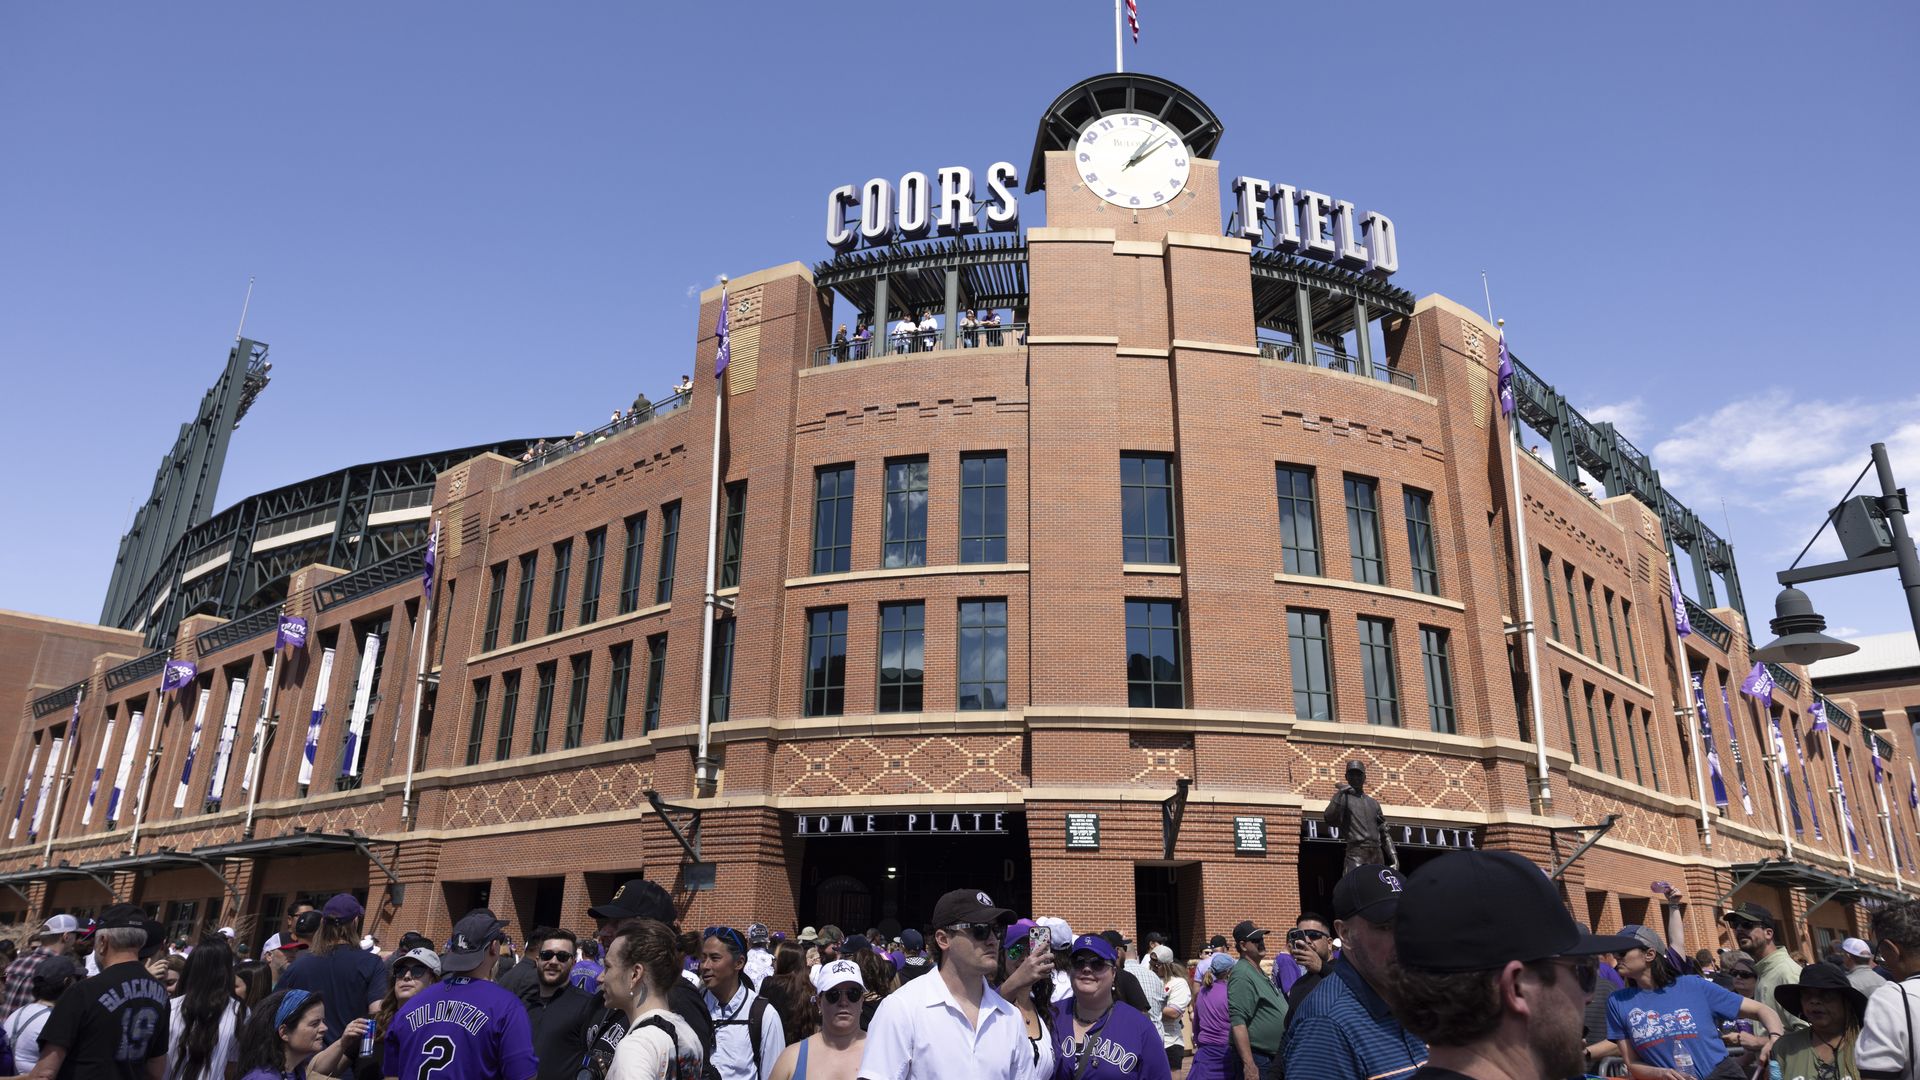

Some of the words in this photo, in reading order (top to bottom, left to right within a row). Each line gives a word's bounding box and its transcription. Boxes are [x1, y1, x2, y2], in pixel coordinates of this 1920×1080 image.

[1099, 120, 1114, 131] 11
[1122, 117, 1139, 126] 12
[1083, 131, 1098, 145] 10
[1079, 152, 1091, 162] 9
[1175, 158, 1186, 167] 3
[1085, 173, 1098, 183] 8
[1169, 178, 1181, 189] 4
[1105, 188, 1117, 198] 7
[1153, 191, 1164, 202] 5
[1129, 196, 1140, 205] 6
[826, 161, 1018, 249] COORS
[1232, 176, 1399, 276] FIELD
[798, 814, 875, 834] HOME
[908, 813, 1004, 832] PLATE
[1307, 820, 1339, 839] HO
[1403, 825, 1476, 849] PLATE
[406, 1000, 489, 1036] TULOWITZKI
[417, 1035, 456, 1080] 2
